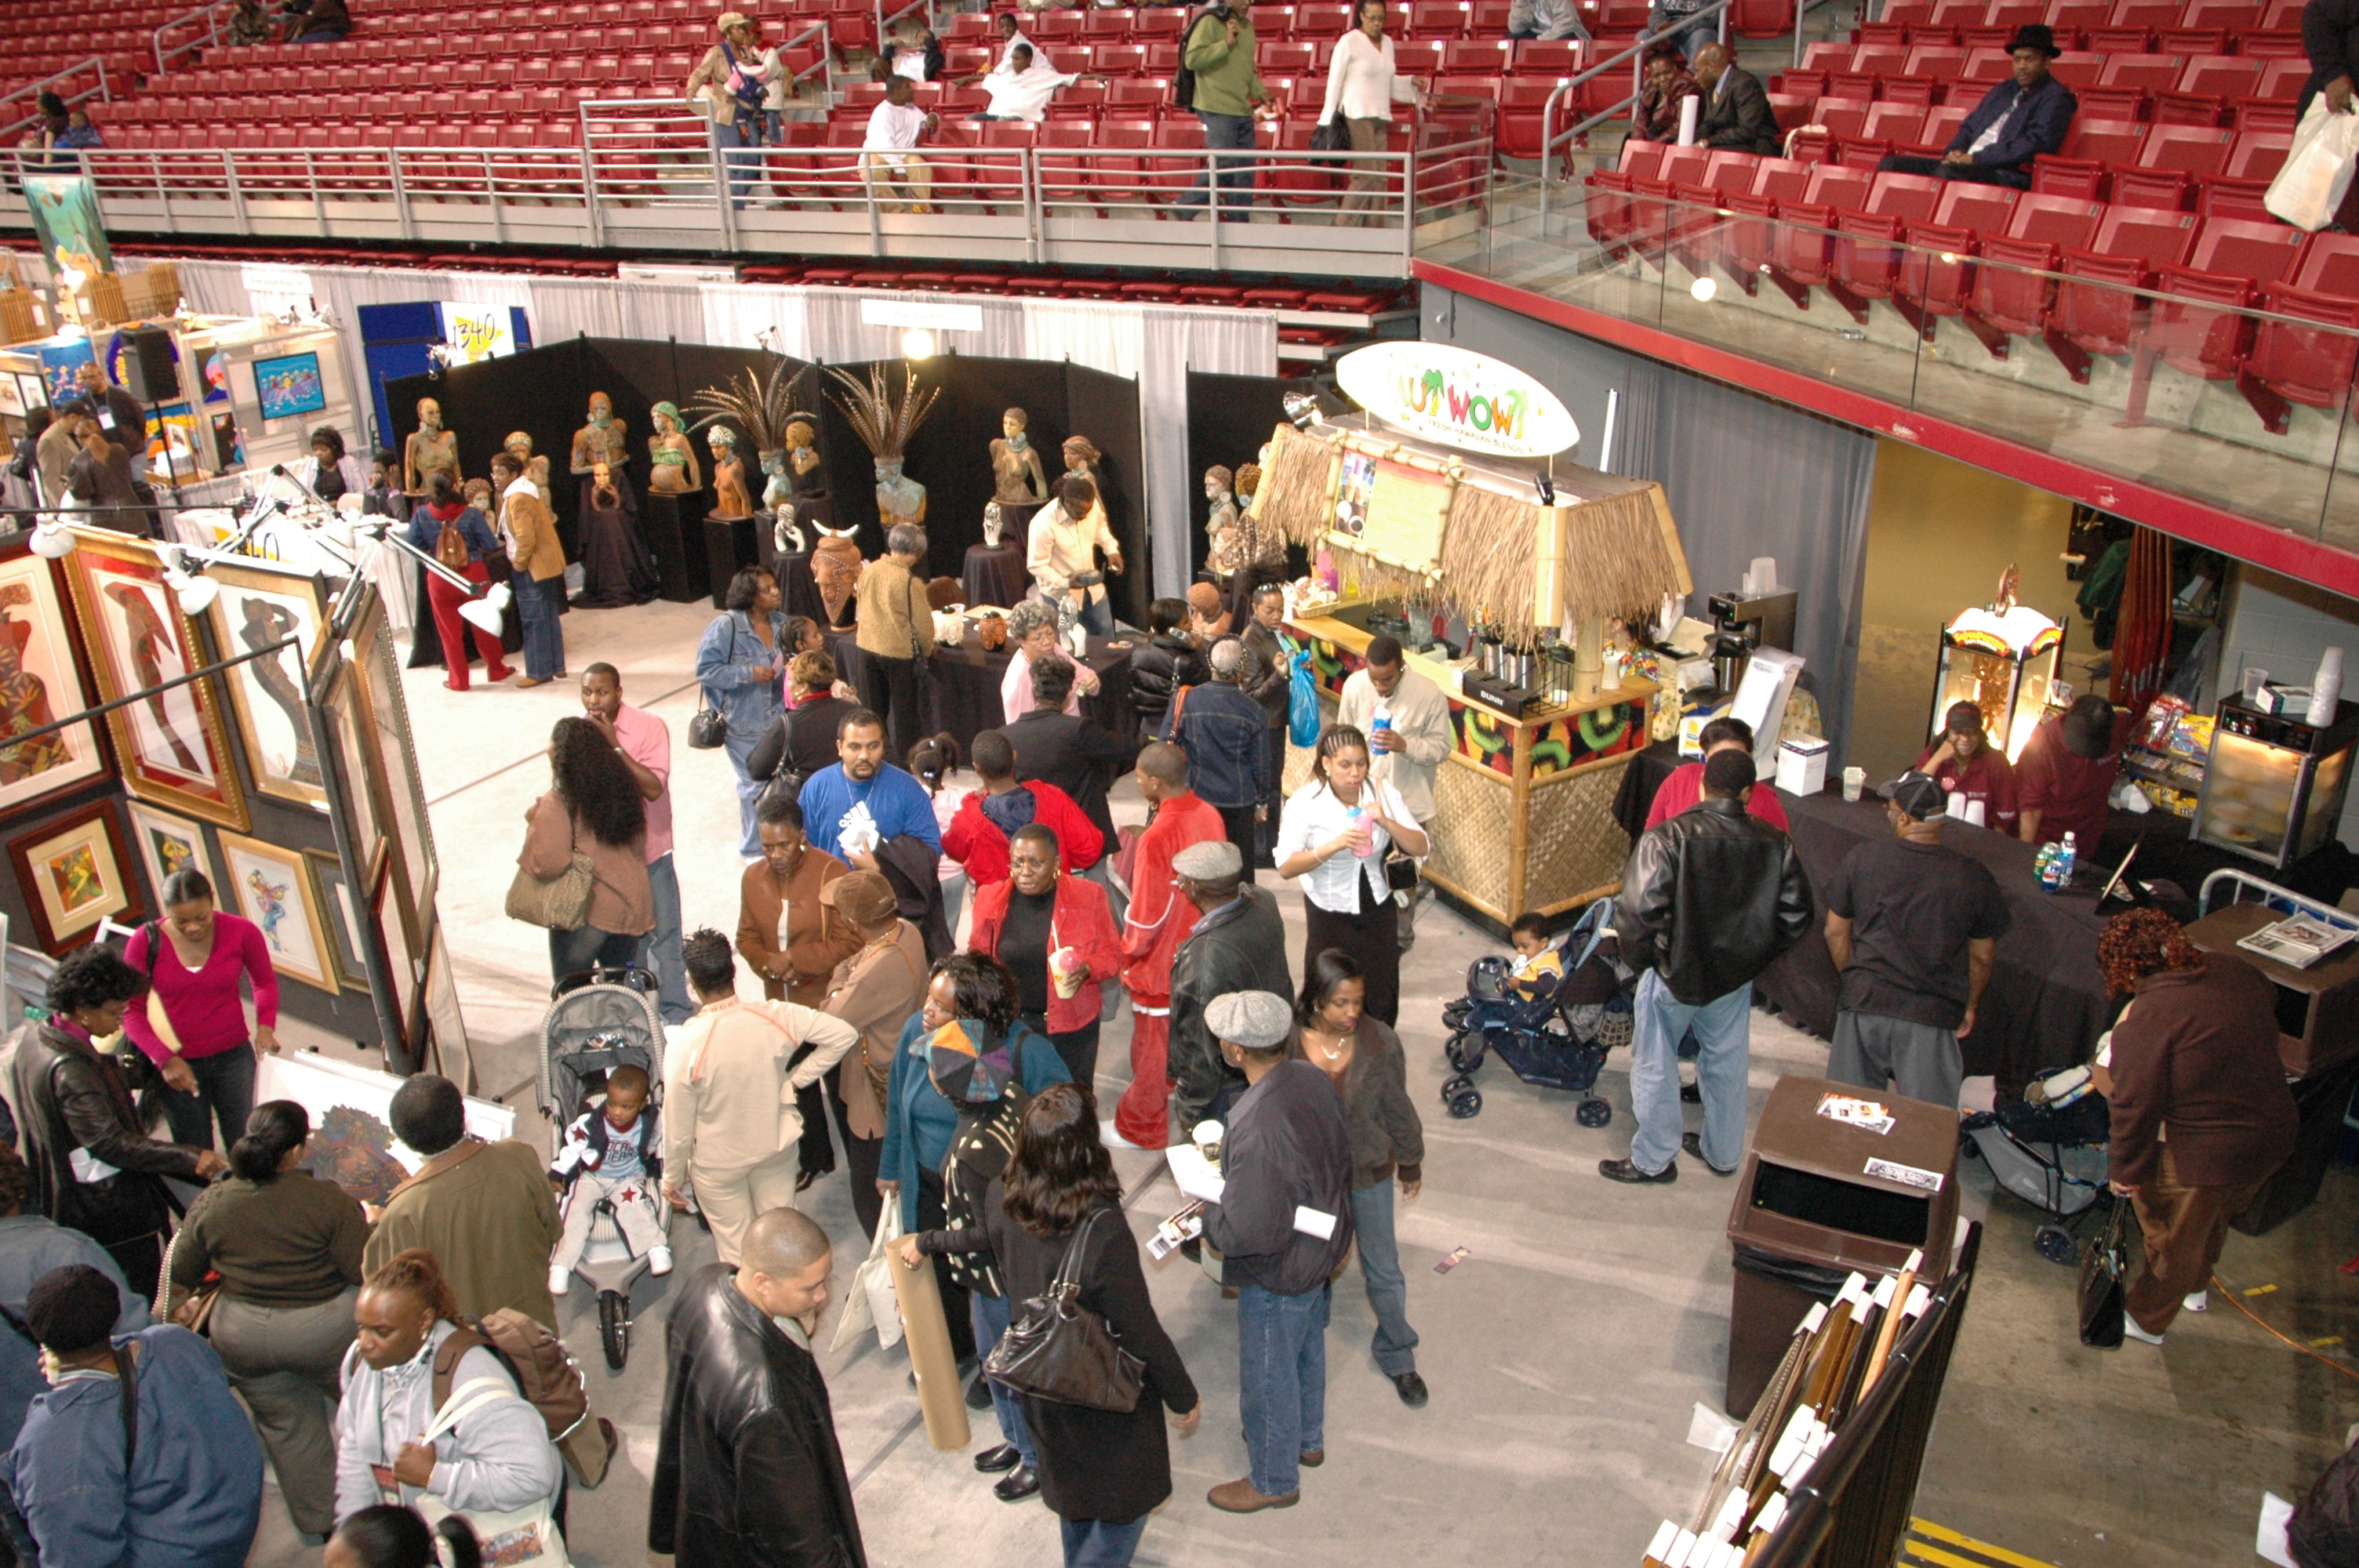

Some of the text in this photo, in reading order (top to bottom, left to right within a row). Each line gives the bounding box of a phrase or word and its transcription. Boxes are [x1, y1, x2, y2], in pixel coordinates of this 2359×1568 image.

[453, 313, 496, 352] 1340
[1428, 419, 1524, 454] FRESH HAWAIIAN BLENDS
[1480, 690, 1504, 706] BUNN
